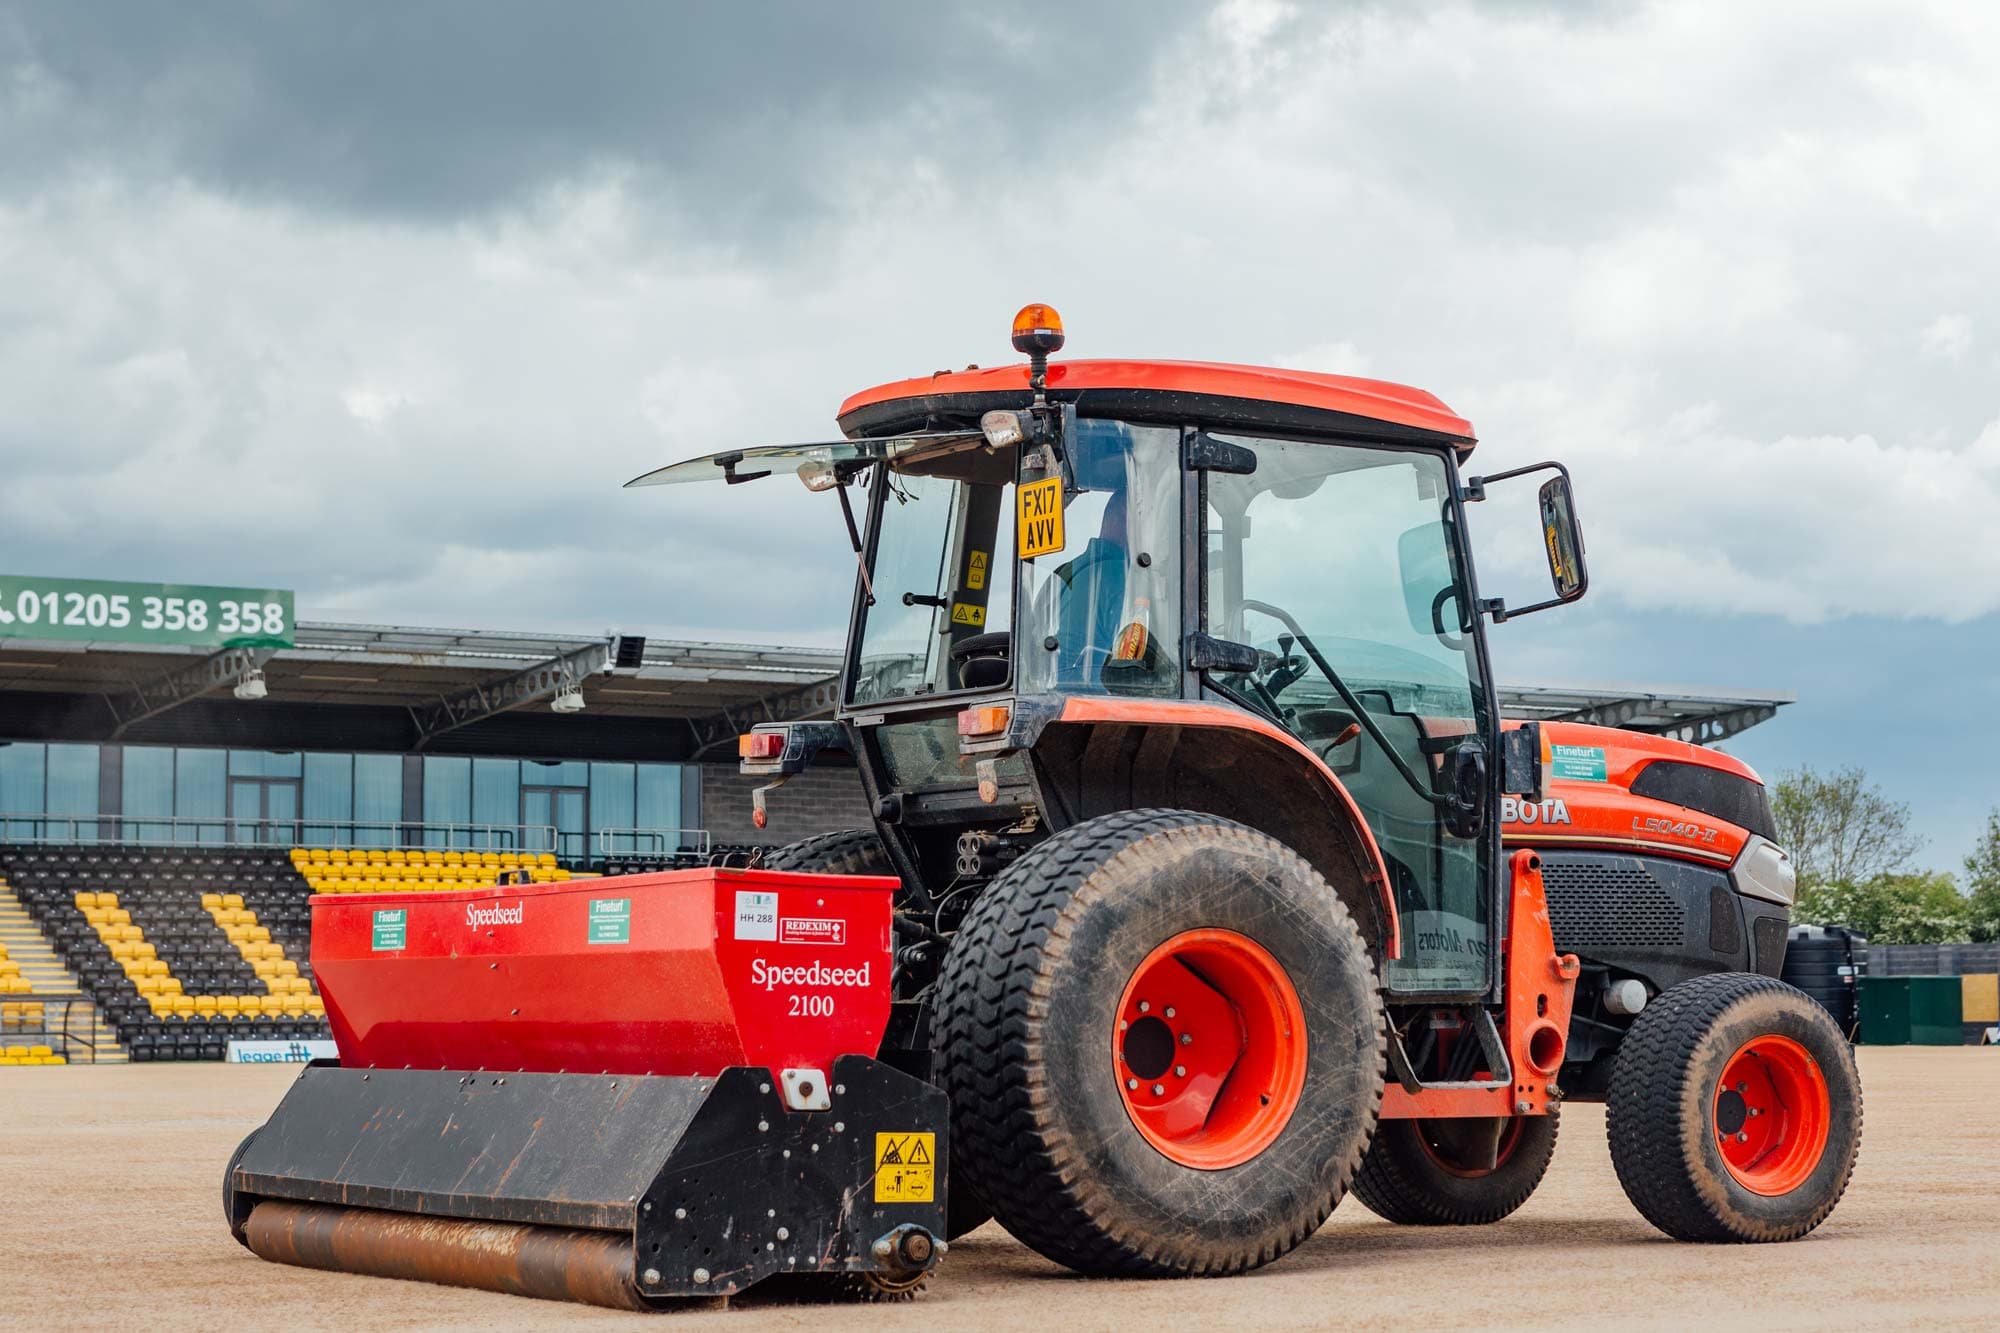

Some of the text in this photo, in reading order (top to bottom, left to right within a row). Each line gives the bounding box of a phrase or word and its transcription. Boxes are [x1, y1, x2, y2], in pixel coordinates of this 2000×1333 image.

[1024, 485, 1056, 518] FX17
[1027, 517, 1055, 549] AVV
[17, 590, 284, 635] 01205 358 358
[1501, 797, 1572, 824] BOTA
[466, 901, 523, 932] Speedseed
[740, 913, 773, 923] HH 288
[785, 920, 832, 932] REDEXIM
[752, 958, 871, 991] Speedseed
[788, 995, 834, 1017] 2100
